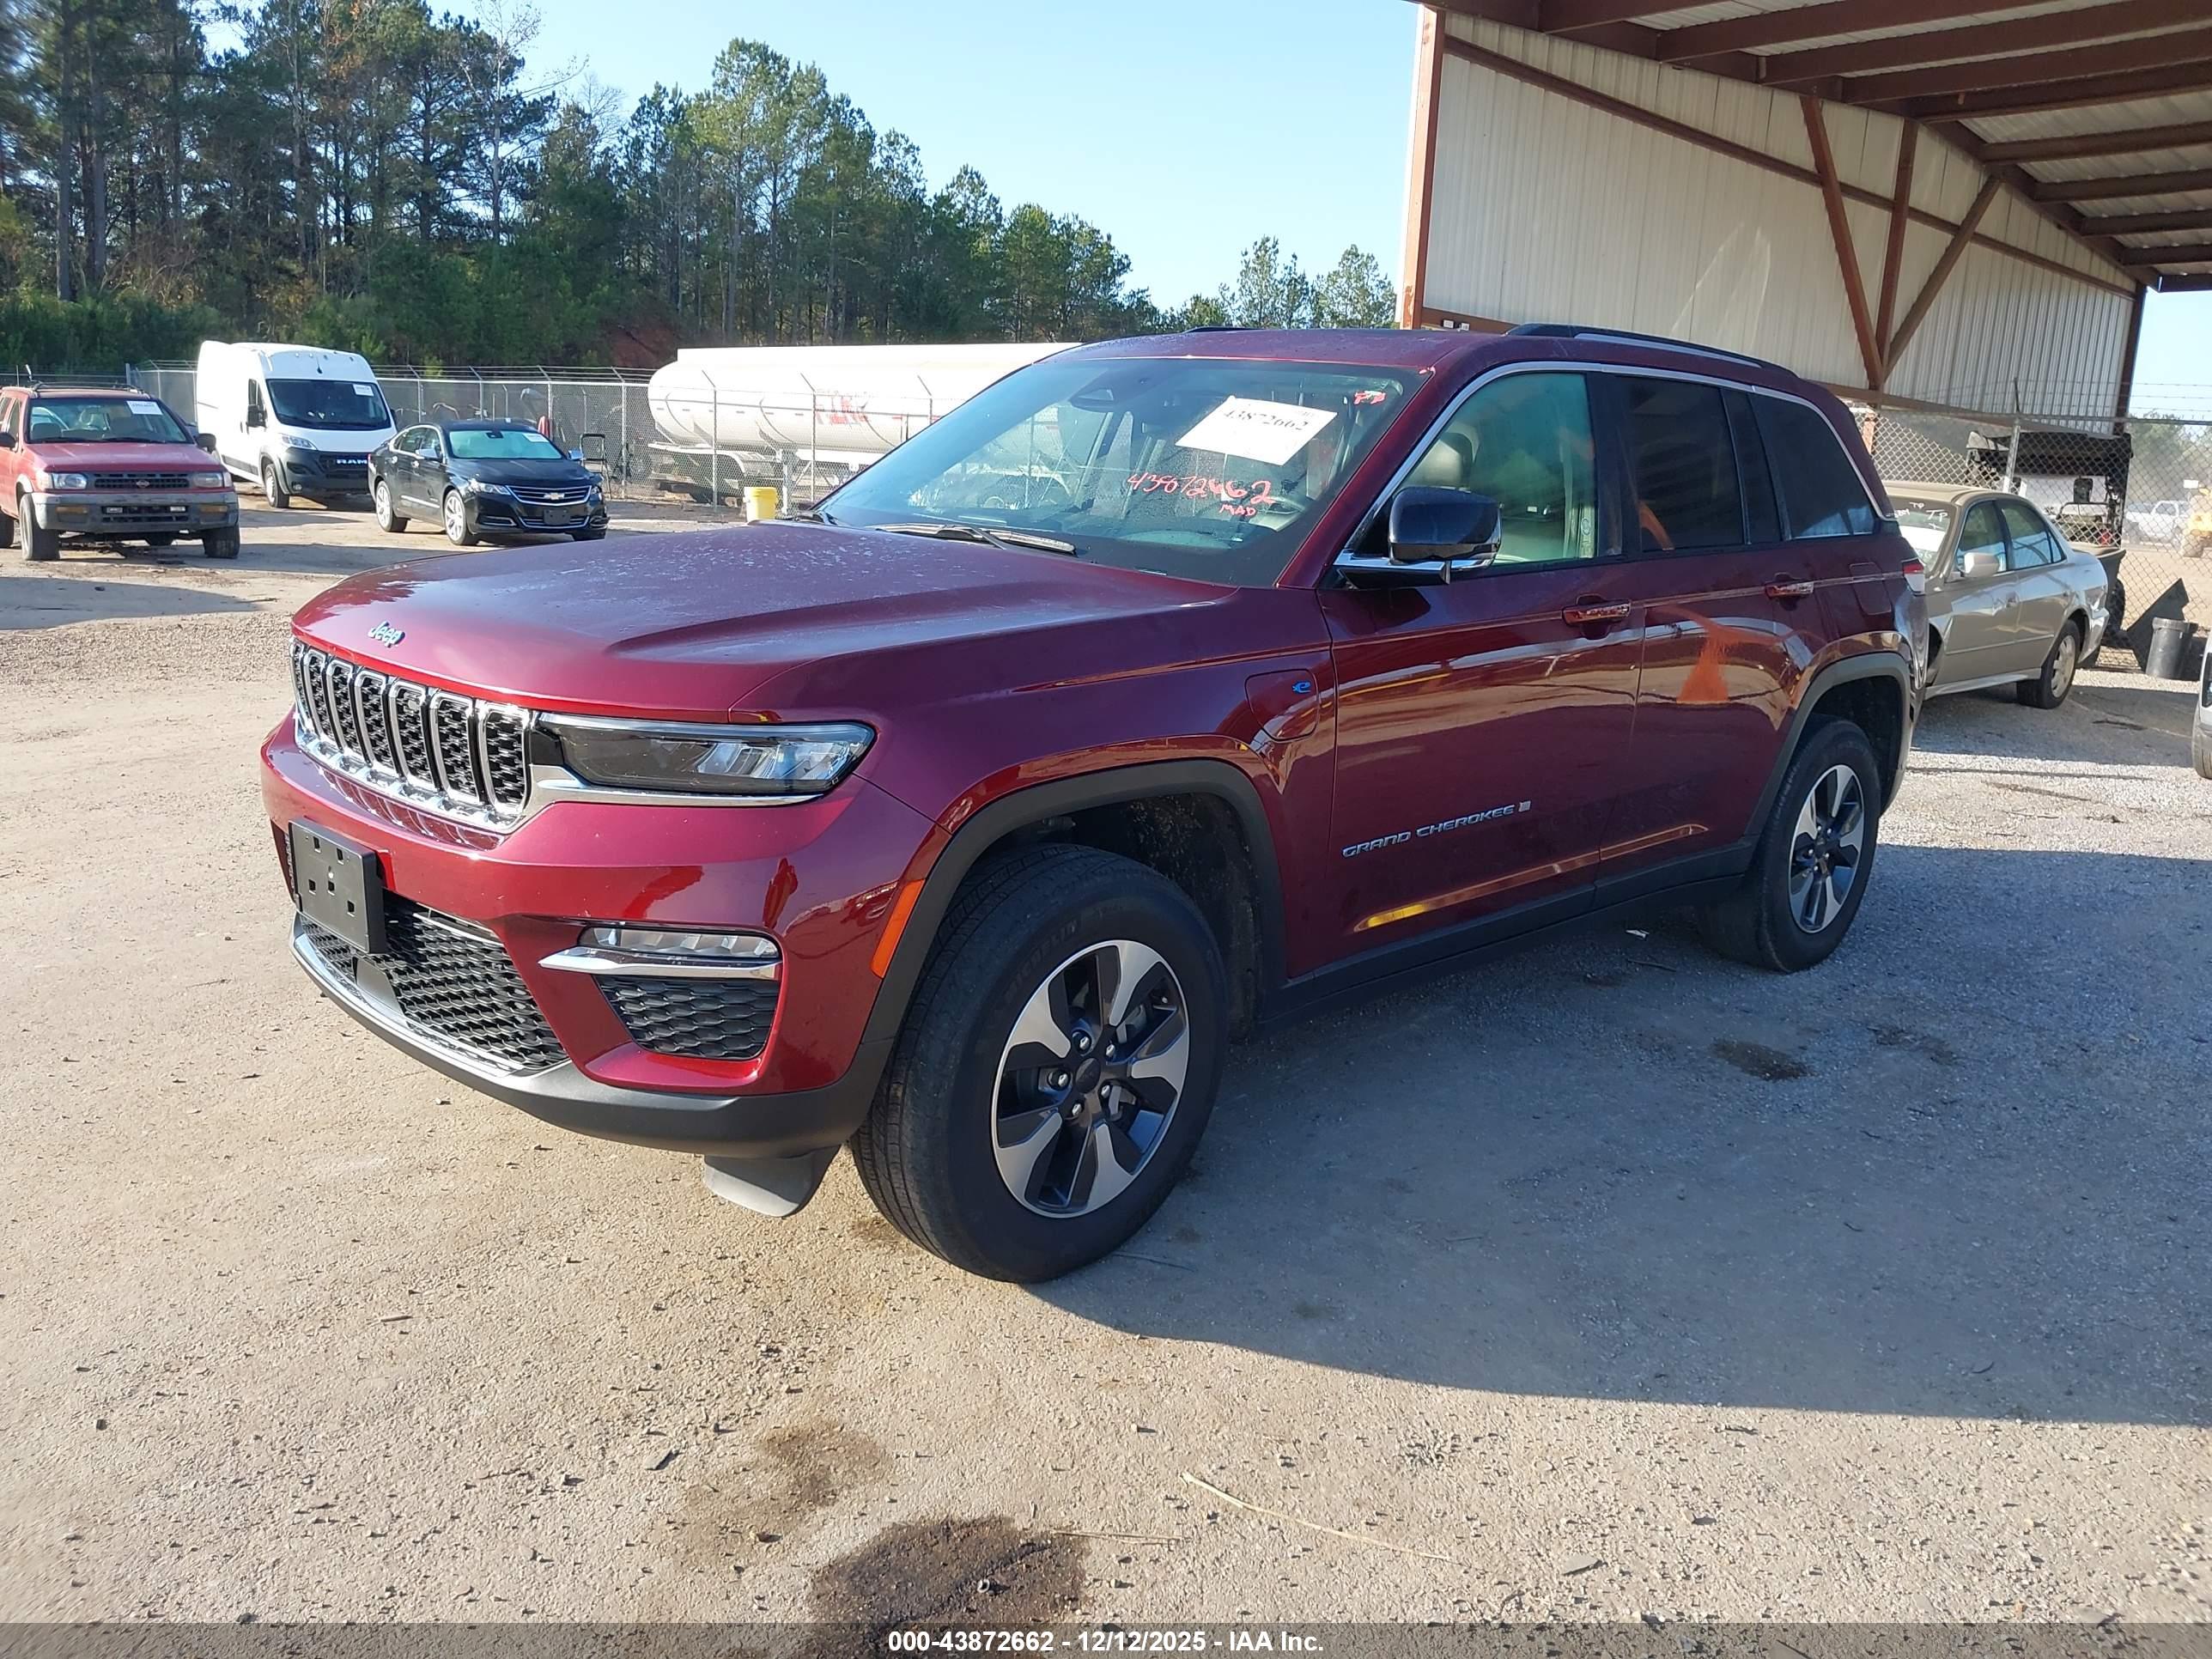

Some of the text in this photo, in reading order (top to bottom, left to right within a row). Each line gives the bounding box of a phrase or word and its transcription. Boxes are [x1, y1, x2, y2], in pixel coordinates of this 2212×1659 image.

[368, 621, 405, 648] Jeep
[1342, 804, 1516, 858] GRAND CHEROKEE
